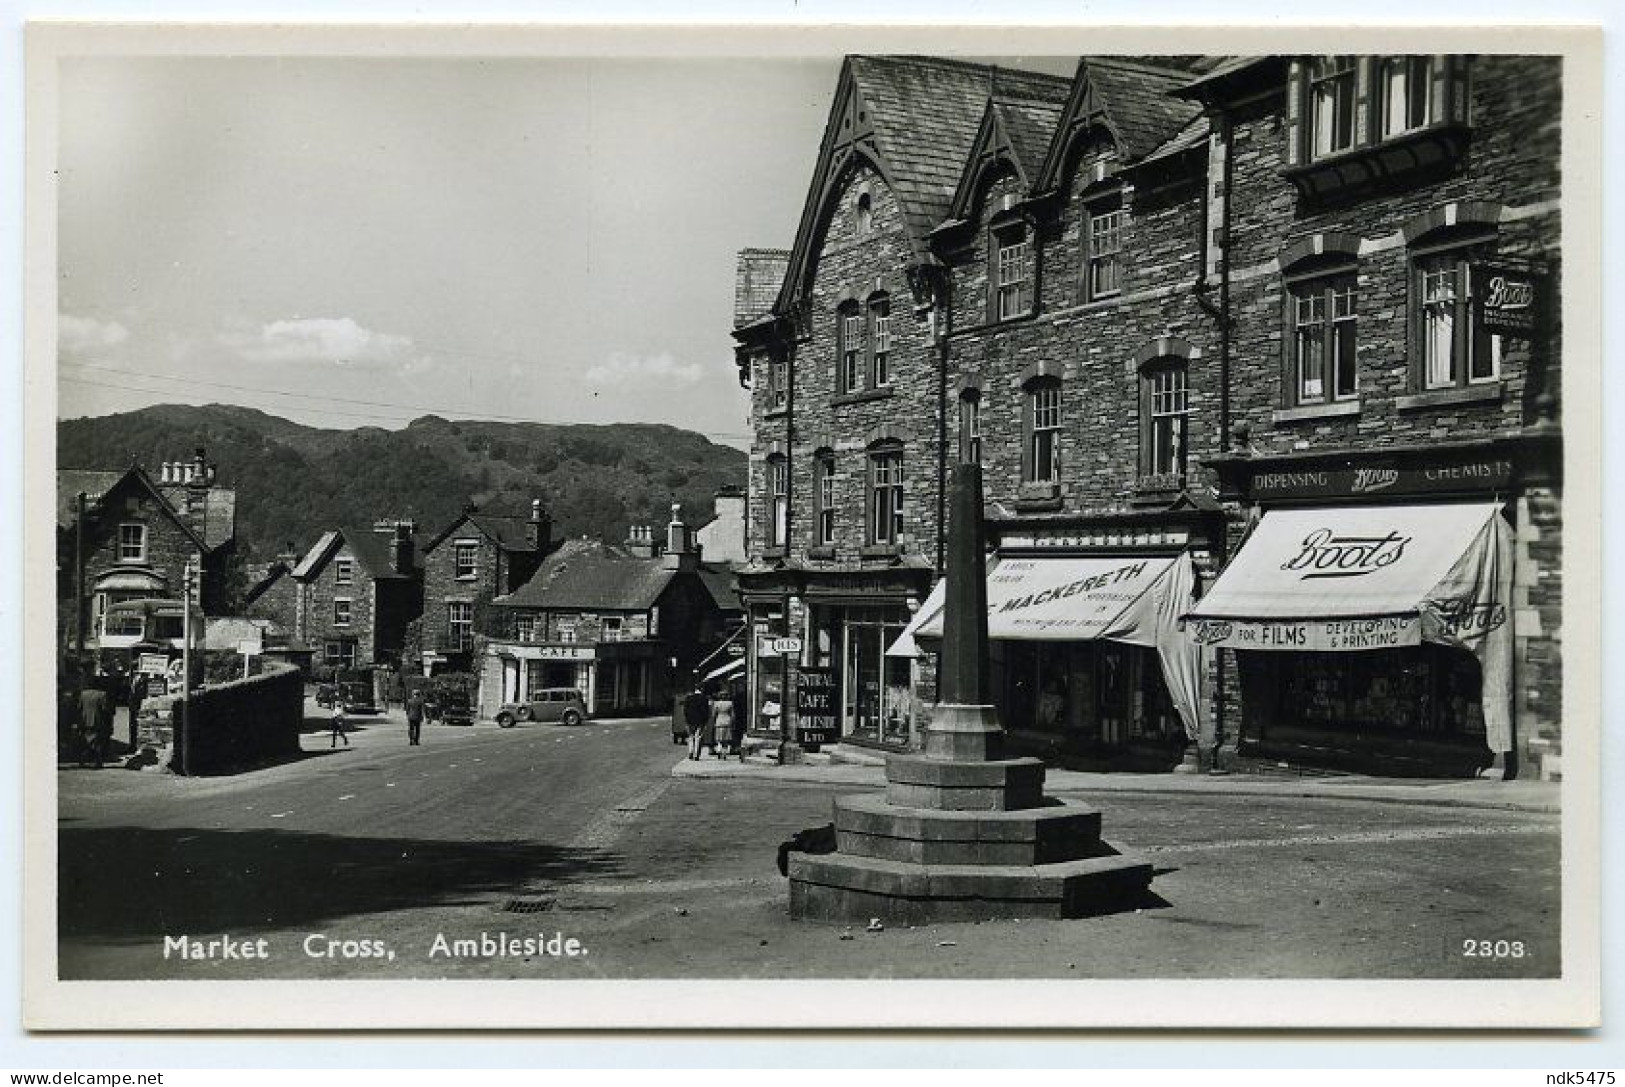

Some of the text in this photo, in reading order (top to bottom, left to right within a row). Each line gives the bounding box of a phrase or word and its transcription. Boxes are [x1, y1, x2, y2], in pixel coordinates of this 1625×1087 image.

[1484, 276, 1533, 309] Boots
[1254, 461, 1512, 492] DISPENSING Boots CHEMISTS
[1280, 527, 1413, 580] Boots
[999, 561, 1148, 613] MACKERETH
[1193, 619, 1307, 646] Boots FOR FILMS
[1326, 617, 1408, 635] DEVELOPING
[1330, 631, 1399, 648] & PRINTING
[539, 647, 579, 658] CAFE
[799, 690, 830, 708] CAFE
